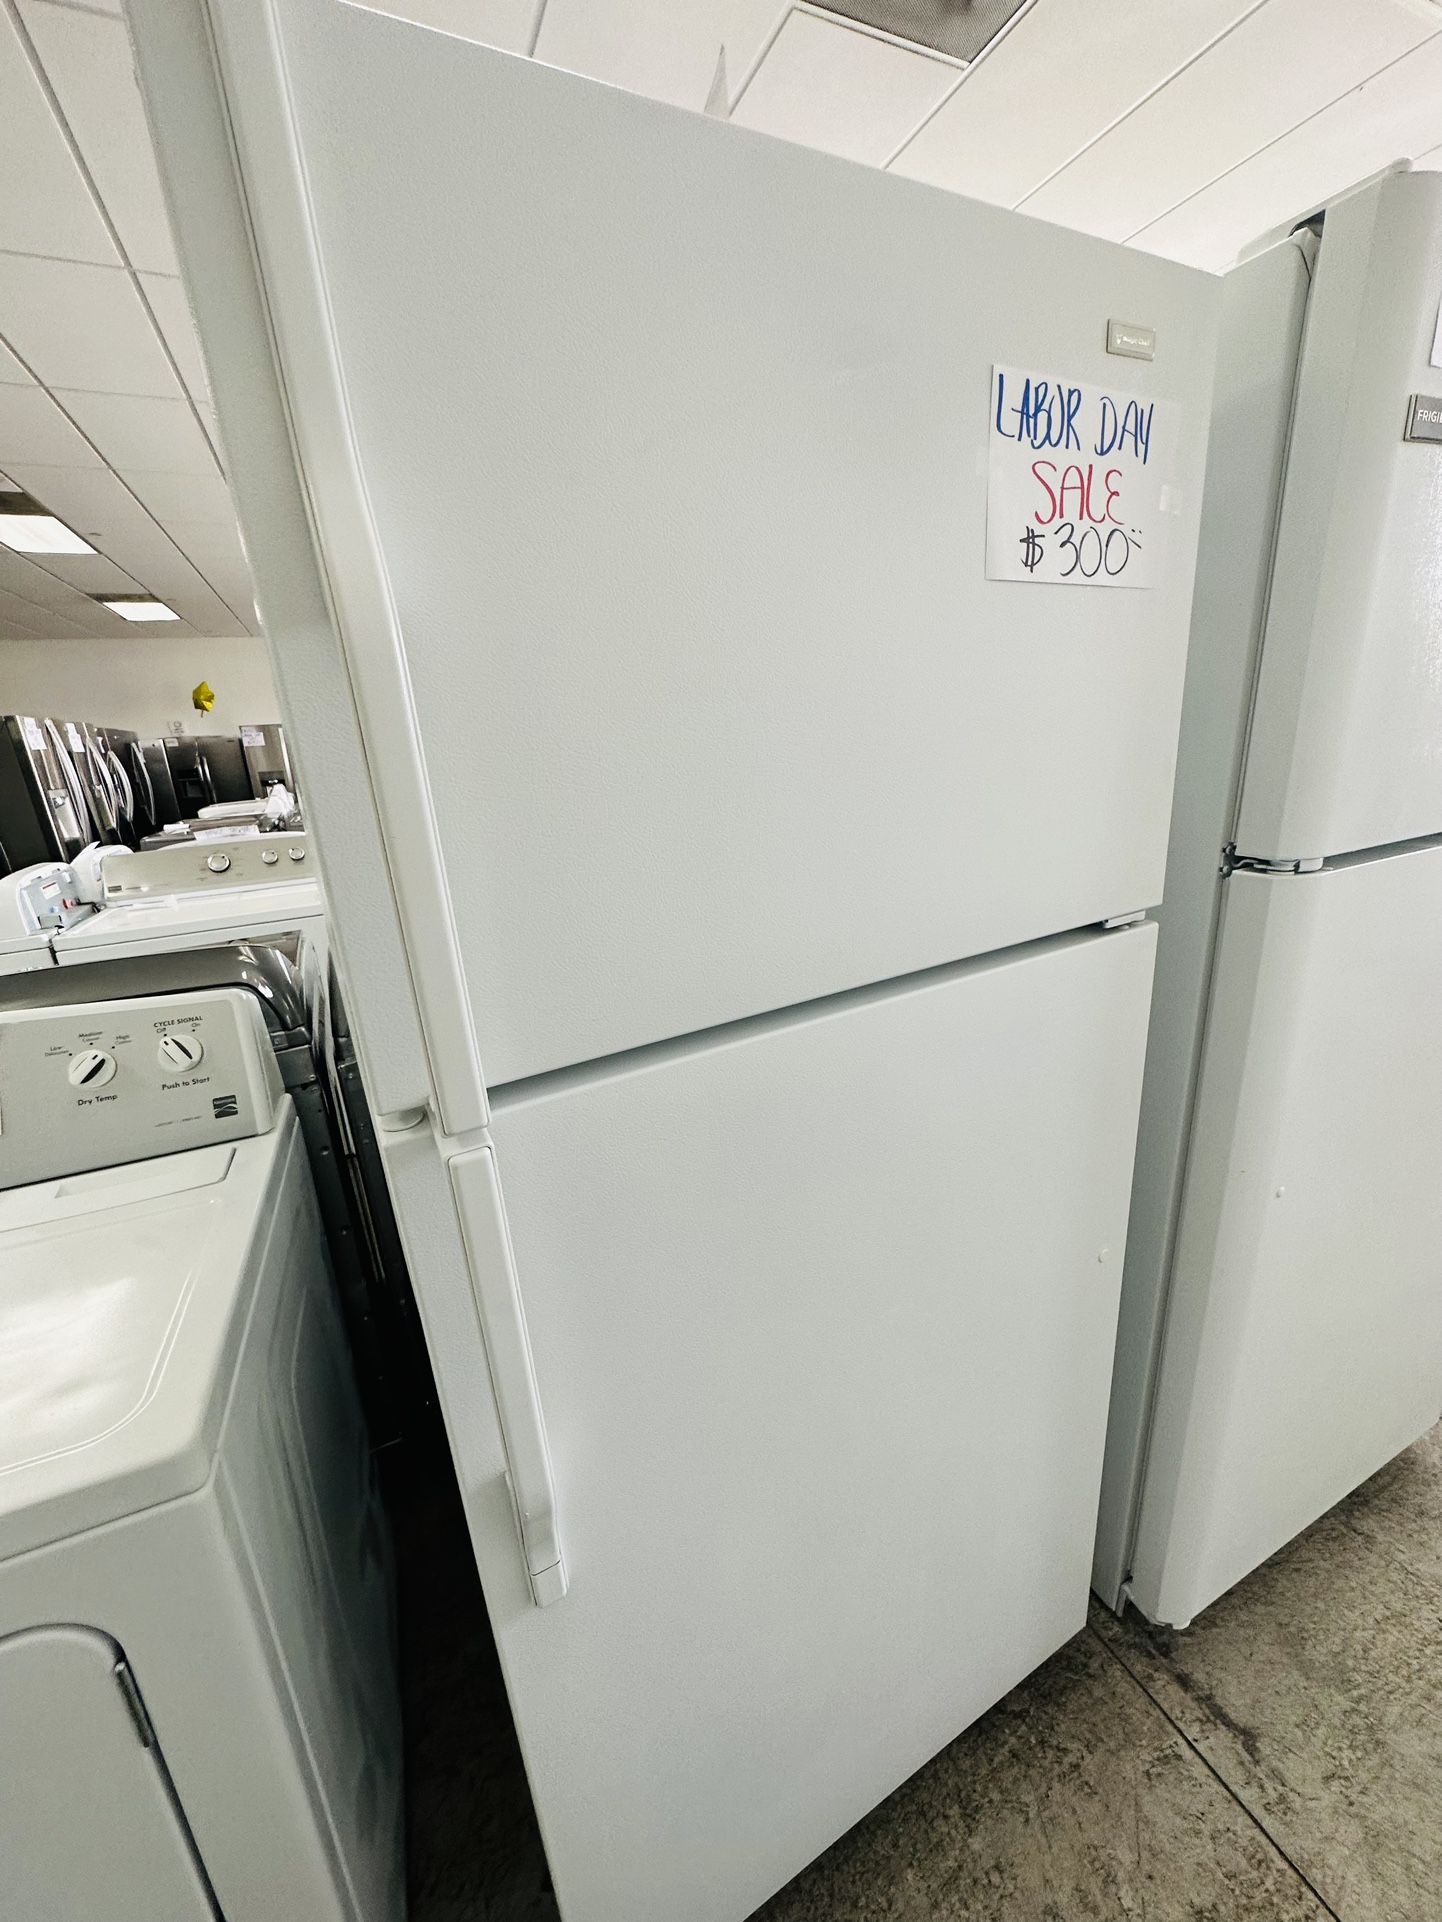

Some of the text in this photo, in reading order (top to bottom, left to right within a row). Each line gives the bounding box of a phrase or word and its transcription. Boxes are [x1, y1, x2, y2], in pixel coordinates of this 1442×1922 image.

[996, 373, 1154, 465] LABOR DAY
[1031, 460, 1124, 525] SALE
[153, 1015, 203, 1028] CYCLE SIGNAL
[161, 1081, 180, 1090] Push
[192, 1076, 210, 1085] Start
[77, 1094, 118, 1106] Dry Temp
